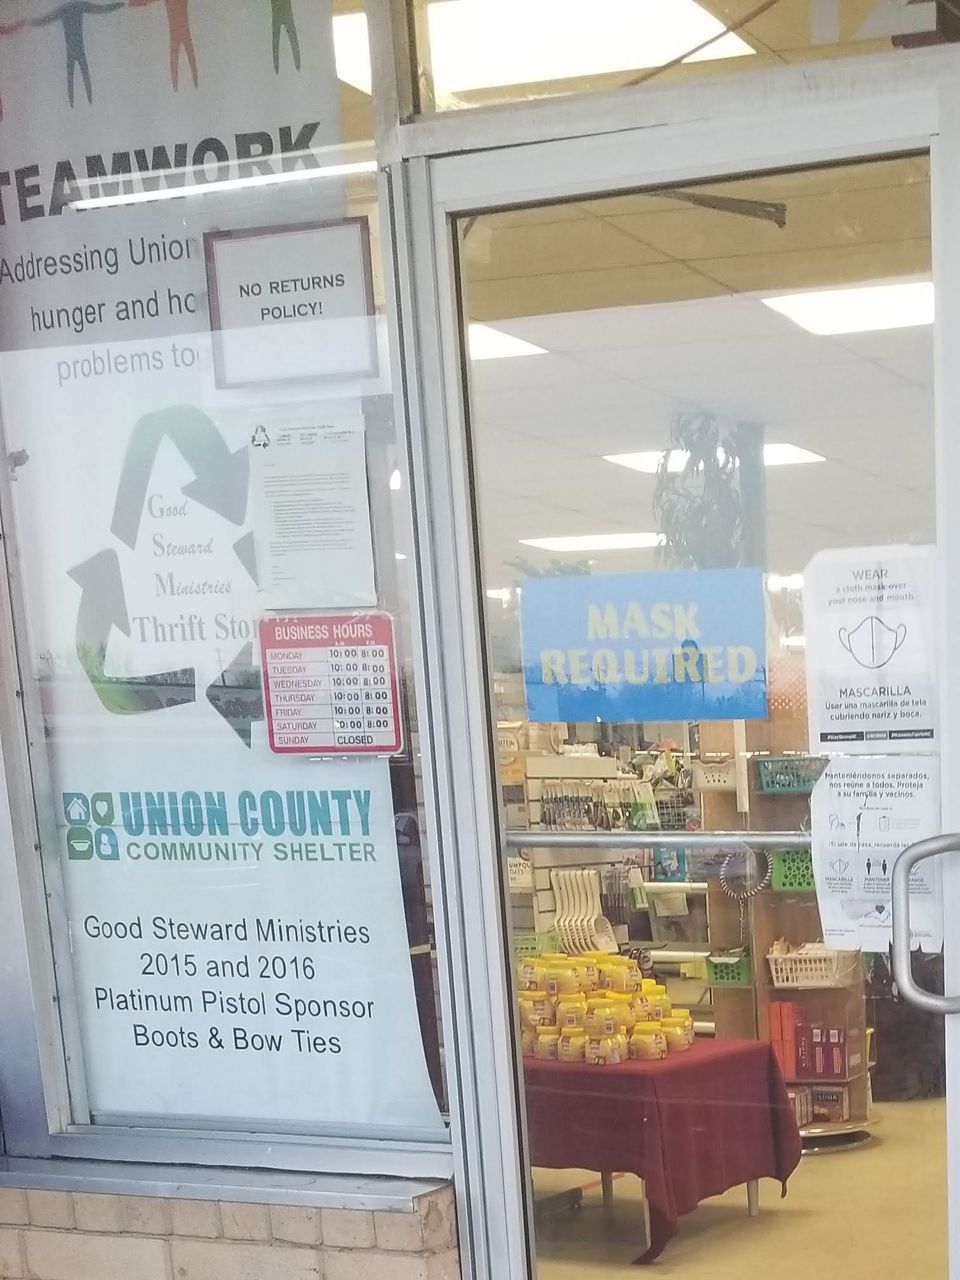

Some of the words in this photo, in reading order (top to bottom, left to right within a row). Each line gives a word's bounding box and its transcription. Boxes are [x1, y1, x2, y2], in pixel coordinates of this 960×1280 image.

[0, 245, 119, 286] Addressing
[240, 283, 262, 298] NO
[269, 274, 345, 294] RETURNS
[31, 302, 105, 333] hunger
[116, 290, 159, 321] and
[261, 302, 323, 320] POLICY!
[57, 348, 163, 387] problems
[148, 494, 188, 519] Good
[152, 533, 213, 557] Steward
[852, 568, 888, 581] WEAR
[155, 572, 231, 597] Ministries
[843, 584, 863, 593] cloth
[865, 582, 886, 591] mask
[828, 597, 845, 606] your
[848, 596, 867, 604] nose
[869, 595, 884, 603] and
[133, 614, 207, 643] Thrift
[587, 601, 701, 640] MASK
[275, 625, 329, 640] BUSINESS
[333, 623, 373, 639] HOURS
[270, 651, 302, 660] MONDAY
[272, 665, 307, 674] TUESDAY
[541, 646, 757, 685] REQUIRED
[273, 680, 322, 688] WEDNESDAY
[839, 685, 911, 698] MASCARILLA
[275, 694, 315, 702] THURSDAY
[825, 701, 843, 710] Usar
[844, 702, 857, 710] una
[860, 700, 898, 709] mascarilla
[900, 699, 910, 707] de
[911, 698, 927, 706] tela
[275, 708, 302, 716] FRIDAY
[830, 711, 870, 721] cubriendo
[871, 711, 891, 719] nariz
[893, 711, 898, 720] y
[900, 710, 922, 719] boca.
[277, 722, 318, 730] SATURDAY
[336, 720, 362, 728] 0:00
[278, 736, 309, 744] SUNDAY
[337, 735, 374, 745] CLOSED
[887, 771, 930, 781] separados,
[853, 789, 877, 798] familia
[885, 790, 915, 798] vecinos.
[872, 781, 895, 789] todos.
[897, 781, 924, 790] Proteja
[120, 790, 230, 836] UNION
[238, 790, 371, 836] COUNTY
[126, 842, 264, 861] COMMUNITY
[274, 843, 377, 862] SHELTER
[84, 915, 143, 939] Good
[152, 916, 248, 941] Steward
[256, 918, 370, 944] Ministries
[140, 953, 197, 977] 2015
[206, 955, 250, 978] and
[258, 955, 316, 980] 2016
[95, 987, 193, 1012] Platinum
[201, 990, 266, 1016] Pistol
[274, 992, 375, 1021] Sponsor
[133, 1024, 199, 1049] Boots
[208, 1027, 224, 1049] &
[232, 1027, 282, 1052] Bow
[290, 1029, 342, 1054] Ties
